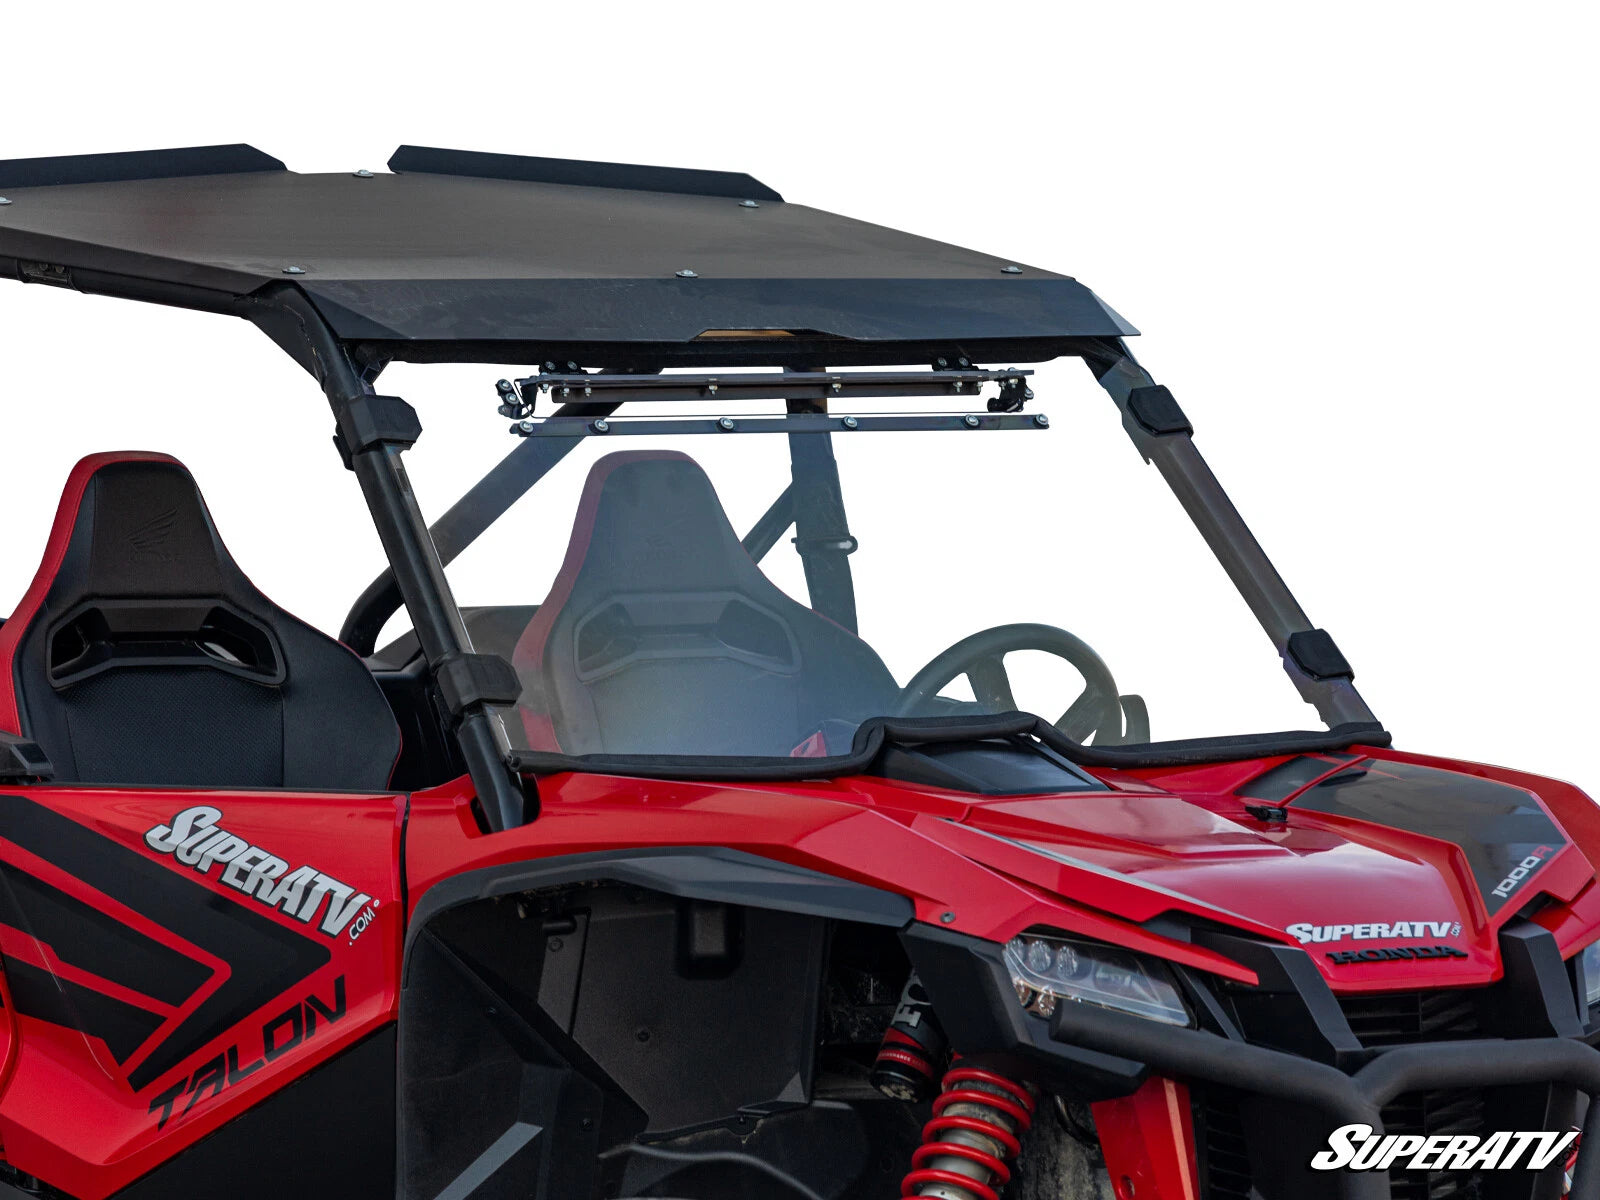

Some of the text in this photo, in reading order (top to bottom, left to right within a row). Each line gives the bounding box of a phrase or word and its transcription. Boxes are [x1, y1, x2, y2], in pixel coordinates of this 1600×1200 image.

[1491, 845, 1554, 898] 1000R
[1285, 921, 1451, 945] SUPERATV
[1325, 945, 1468, 965] HONDA
[148, 974, 347, 1132] TALON
